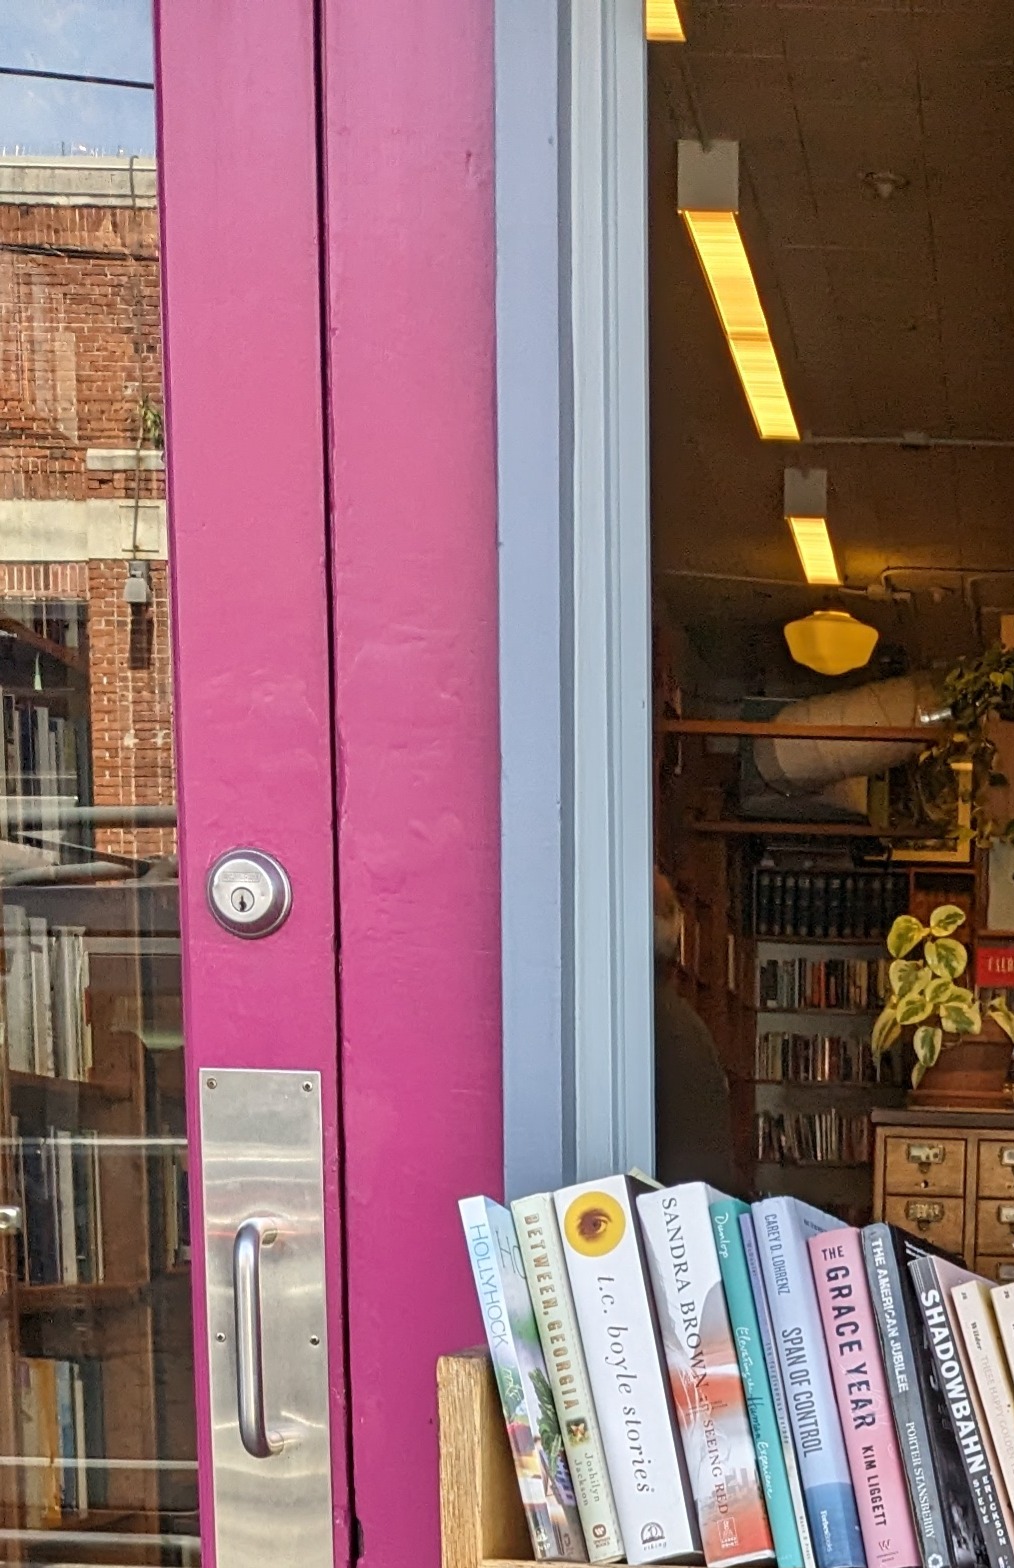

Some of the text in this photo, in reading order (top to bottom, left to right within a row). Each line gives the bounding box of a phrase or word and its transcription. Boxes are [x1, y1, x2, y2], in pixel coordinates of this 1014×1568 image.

[469, 1223, 509, 1349] HOLLYHOCK
[662, 1197, 709, 1388] SANDRA BROWN
[714, 1212, 729, 1259] Dunlop
[822, 1246, 845, 1261] THE
[826, 1265, 876, 1430] GRACE YEAR
[871, 1237, 909, 1393] THE AMERICAN JUBILEE
[971, 1321, 983, 1351] Wilder
[782, 1327, 822, 1458] SPAN OF CONTROL
[921, 1289, 987, 1475] SHADOWBAHN
[703, 1418, 729, 1514] SEEING RED
[861, 1445, 887, 1527] KIM LIGGETT
[906, 1422, 935, 1539] PORTER STANSBERRY
